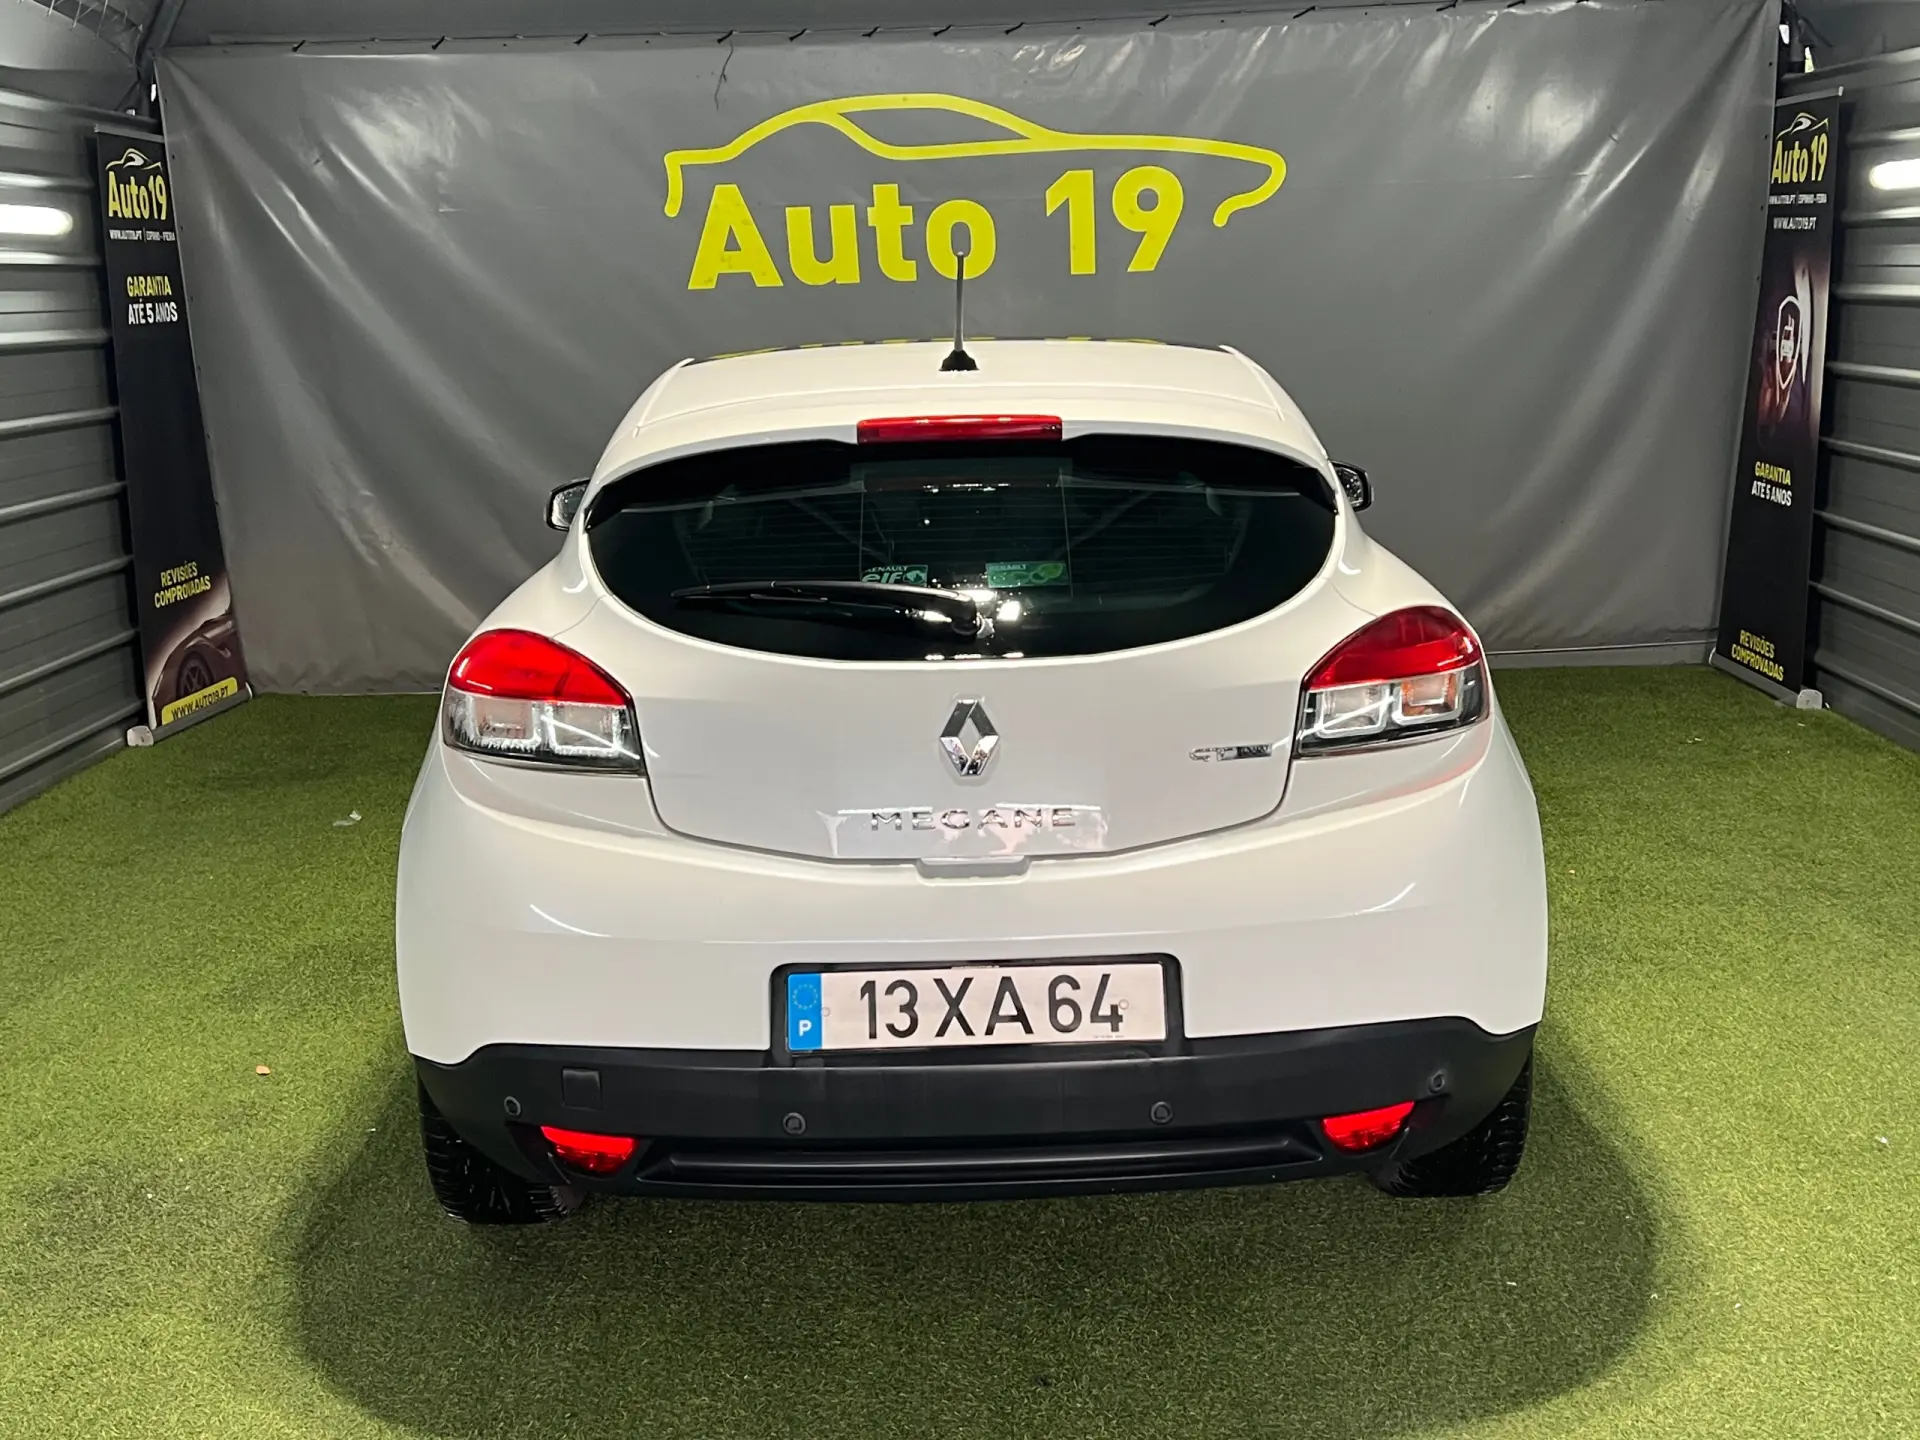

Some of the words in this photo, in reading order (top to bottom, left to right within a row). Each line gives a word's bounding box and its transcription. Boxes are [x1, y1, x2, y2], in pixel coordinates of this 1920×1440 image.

[1771, 140, 1809, 184] Auto
[1811, 133, 1828, 181] 19
[108, 171, 150, 220] Auto
[148, 175, 167, 220] 19
[688, 183, 996, 290] Auto
[1045, 165, 1184, 275] 19
[127, 275, 172, 297] GARANTIA
[128, 298, 146, 325] ATÉ
[146, 302, 154, 324] 5
[155, 301, 178, 323] ANOS
[1755, 460, 1791, 486] GARANTIA
[1751, 479, 1766, 498] ATÉ
[1766, 484, 1771, 500] 5
[1770, 486, 1792, 506] ANOS
[160, 560, 198, 588] REVISÕES
[861, 572, 903, 585] elf
[154, 575, 211, 608] COMPROVADAS
[1740, 629, 1775, 659] REVISÕES
[1731, 643, 1784, 682] COMPROVADAS
[170, 684, 229, 721] WWW.AUTO19.PT
[871, 807, 1076, 832] MEGANE
[859, 979, 918, 1040] 13
[933, 975, 1035, 1038] XA
[1047, 973, 1124, 1034] 64
[798, 1019, 813, 1037] P
